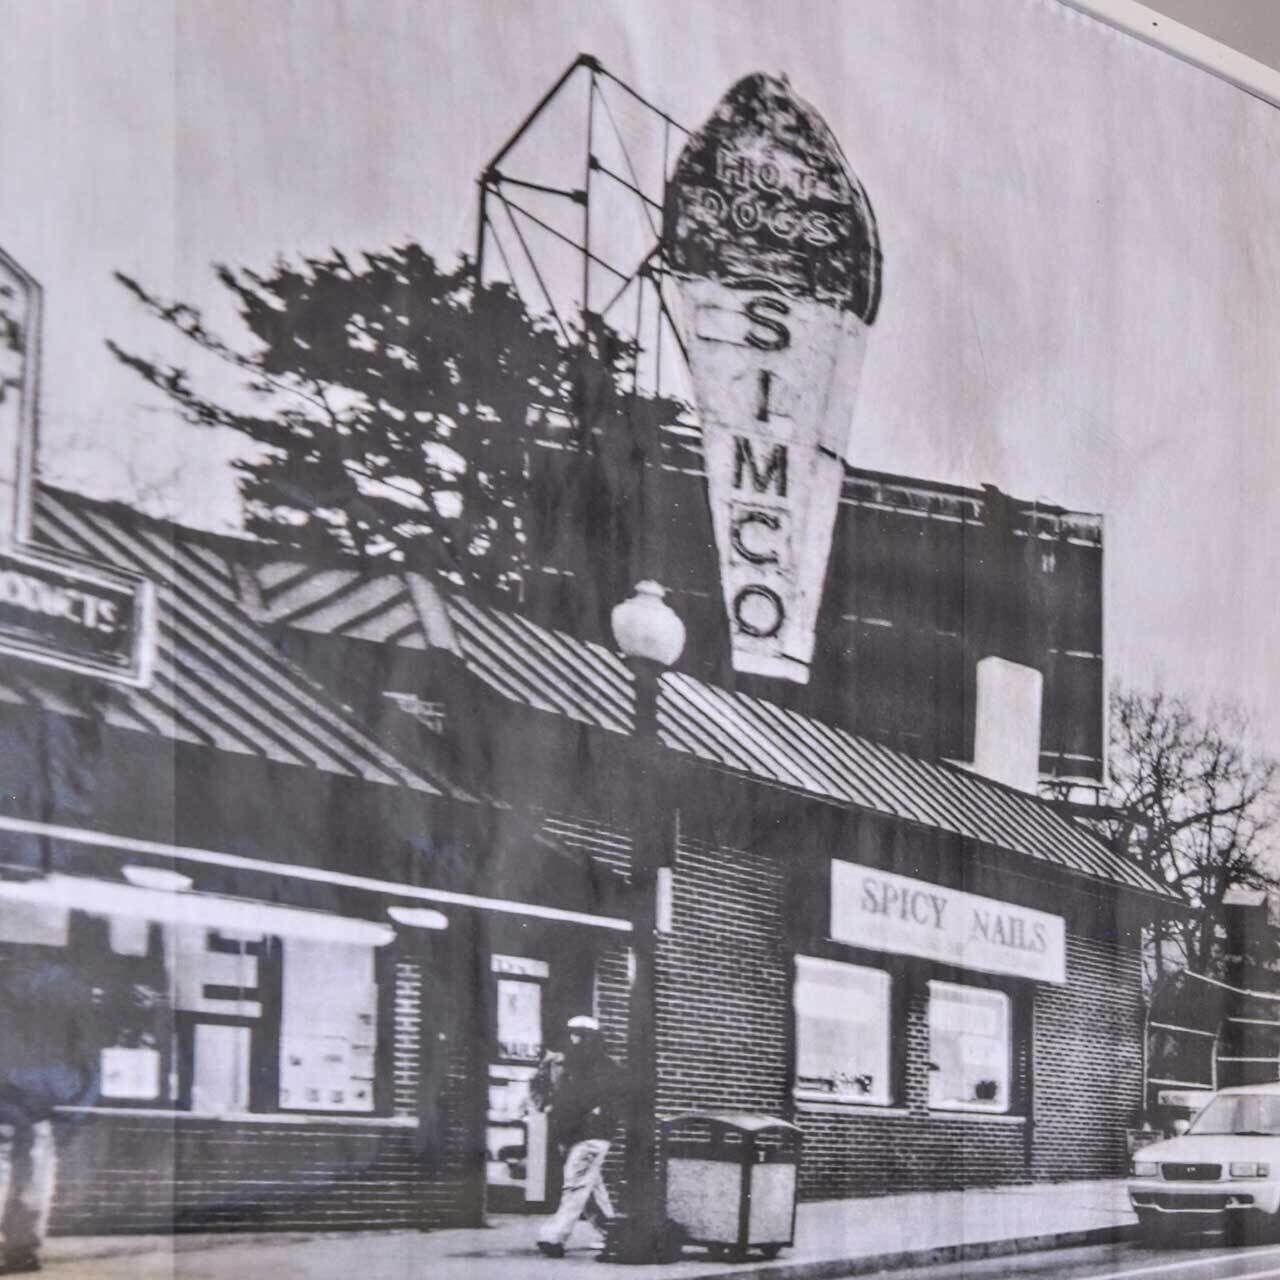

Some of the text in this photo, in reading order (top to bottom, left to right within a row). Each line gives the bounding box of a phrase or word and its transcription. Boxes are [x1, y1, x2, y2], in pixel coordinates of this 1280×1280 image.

[716, 150, 819, 200] HOT
[687, 189, 838, 247] DOGS
[731, 297, 791, 638] SIMCO
[860, 878, 1047, 953] SPICY NAILS
